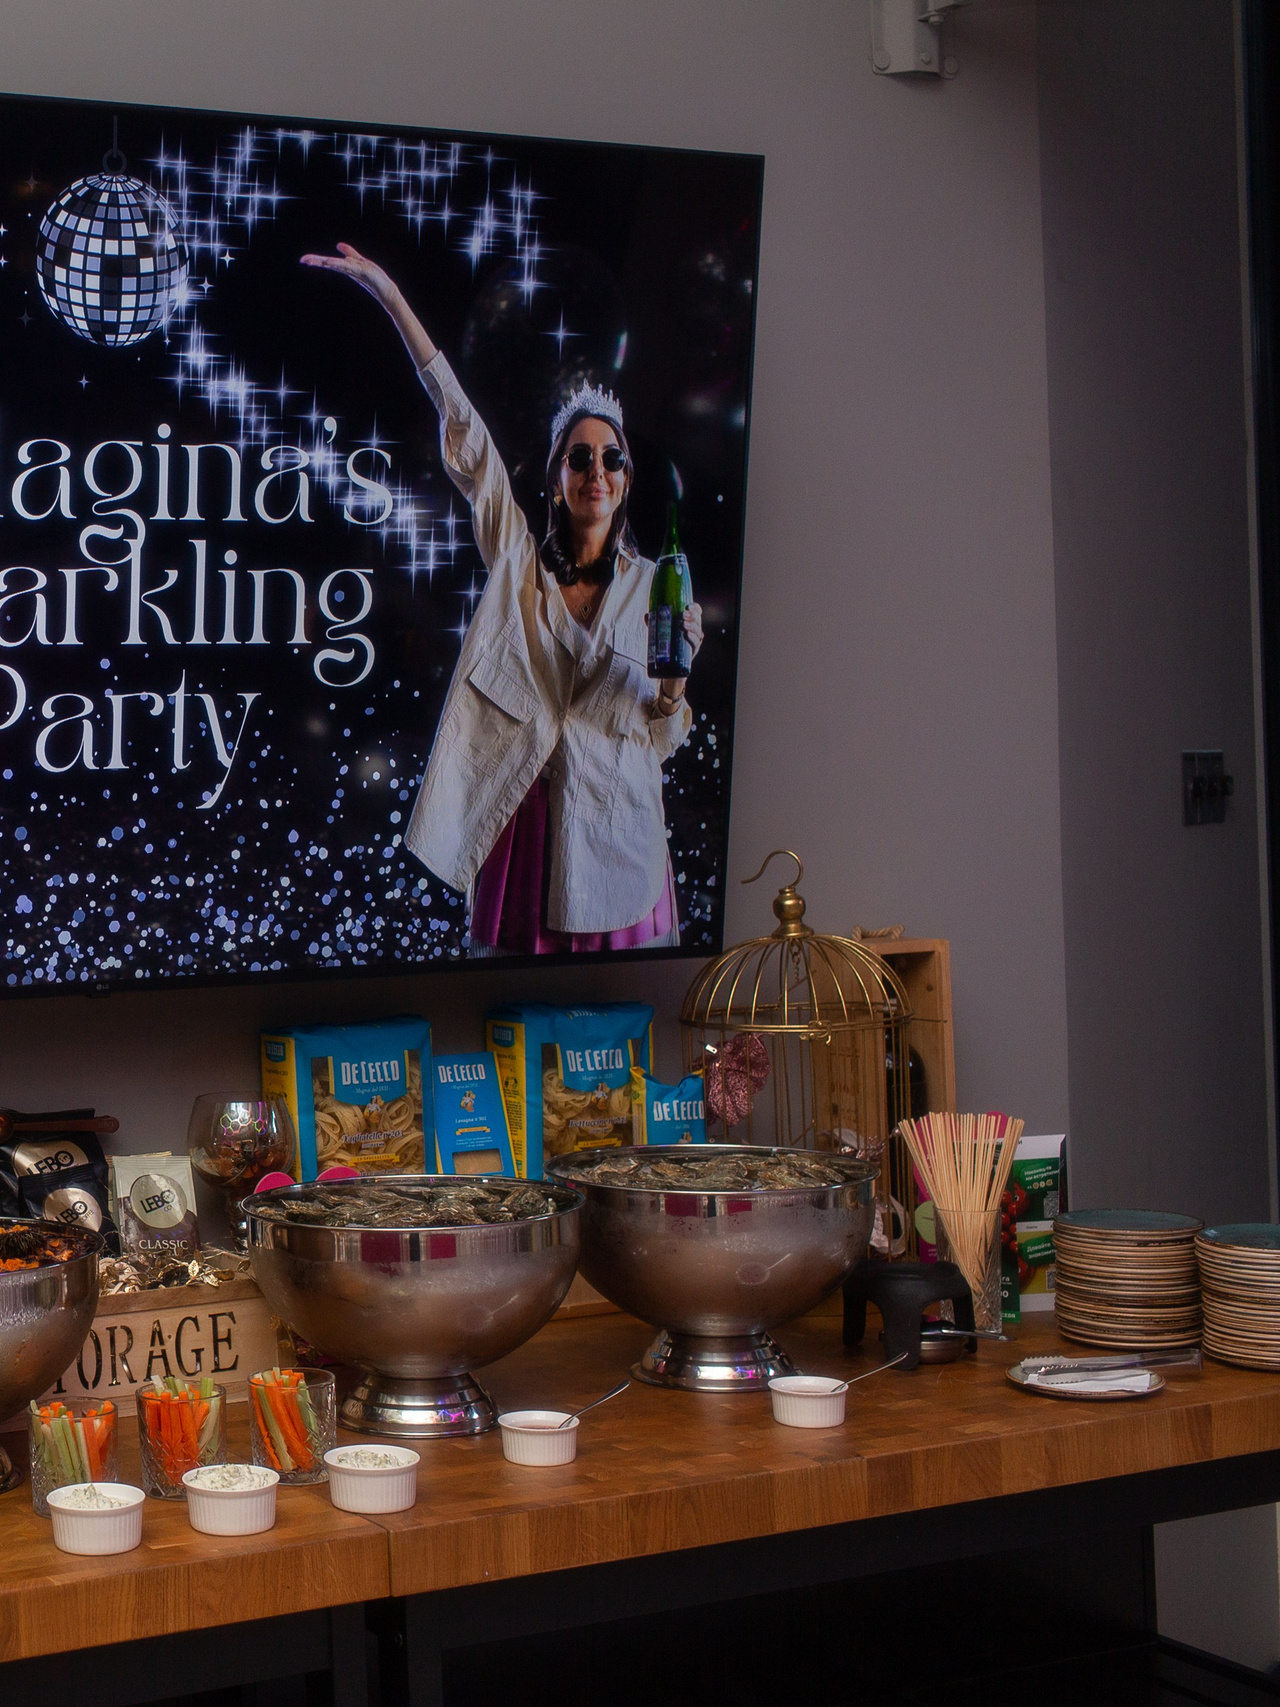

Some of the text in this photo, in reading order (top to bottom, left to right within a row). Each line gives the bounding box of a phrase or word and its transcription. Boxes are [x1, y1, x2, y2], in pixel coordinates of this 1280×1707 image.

[585, 1048, 624, 1071] CECCO
[361, 1060, 400, 1084] CECCO
[453, 1063, 486, 1082] CECCO
[672, 1100, 705, 1121] CECCO
[140, 1189, 176, 1214] LEBO
[138, 1239, 189, 1250] CLASSIC
[53, 1311, 239, 1394] ORAGE
